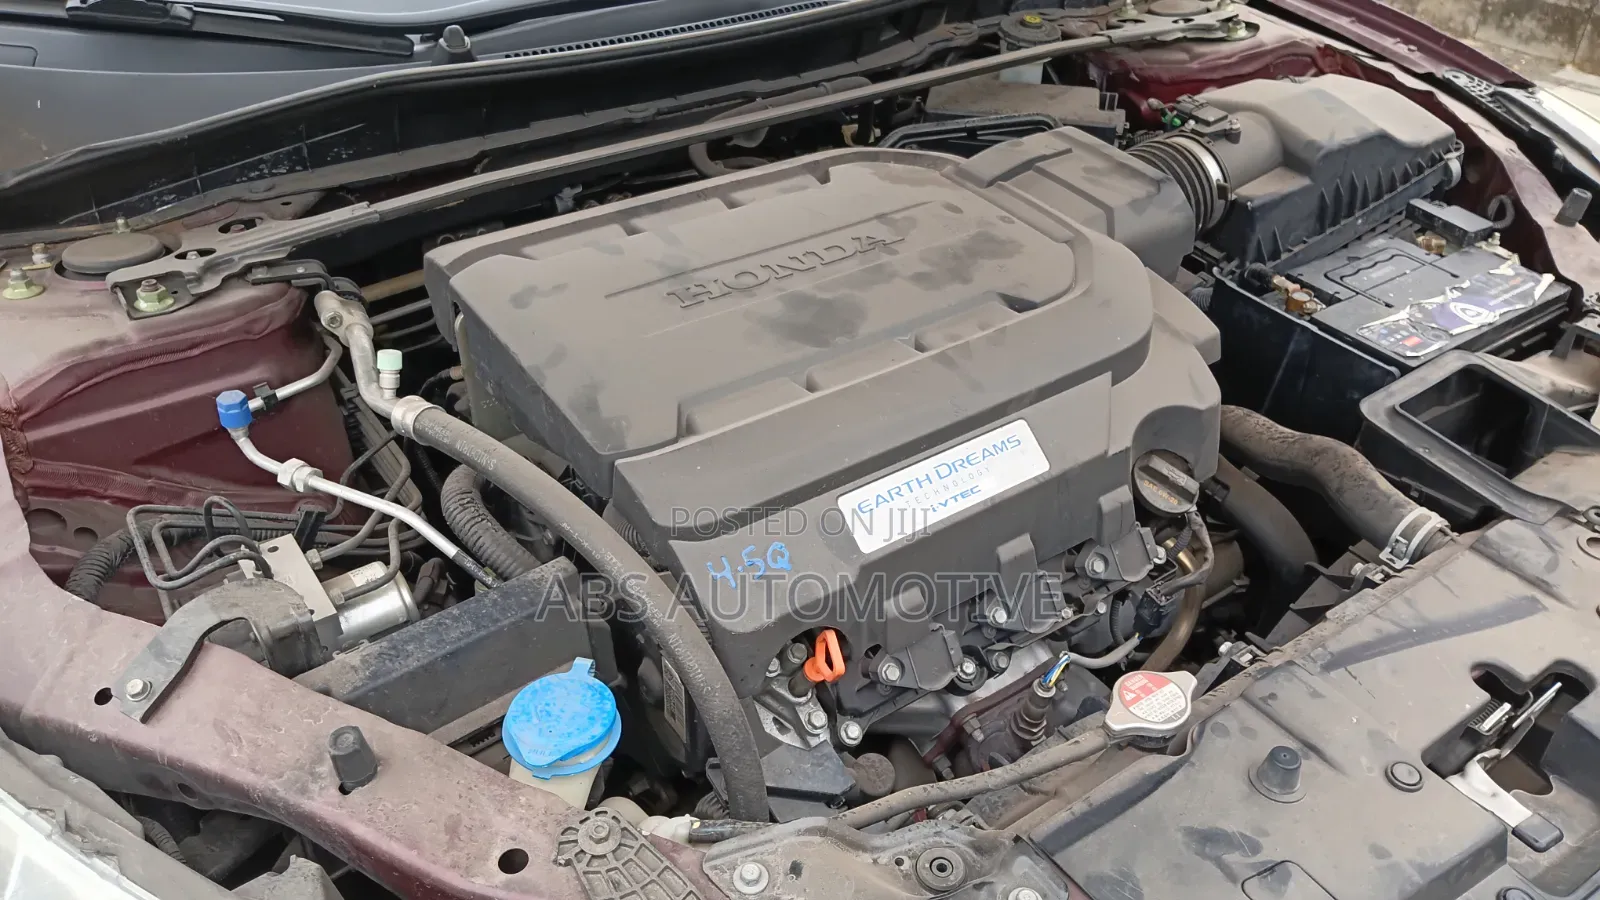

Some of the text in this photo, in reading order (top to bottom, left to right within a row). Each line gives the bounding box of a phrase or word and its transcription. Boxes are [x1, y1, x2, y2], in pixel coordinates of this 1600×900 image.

[665, 235, 905, 309] HONDA
[857, 434, 1022, 514] EARTH DREAMS
[905, 466, 991, 508] TECHNOLOGY
